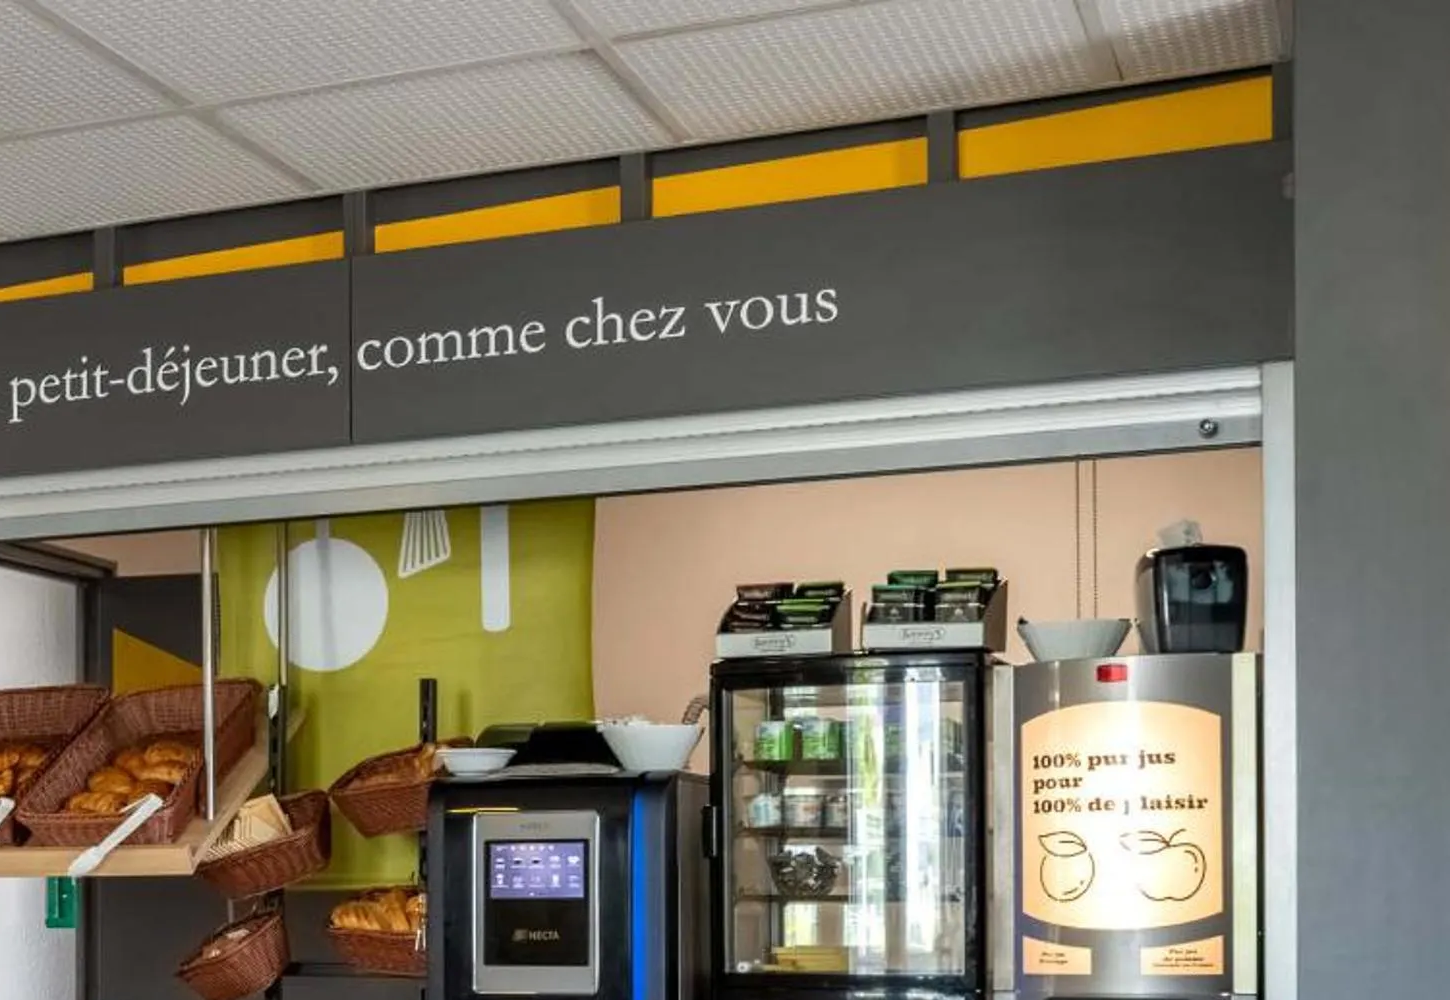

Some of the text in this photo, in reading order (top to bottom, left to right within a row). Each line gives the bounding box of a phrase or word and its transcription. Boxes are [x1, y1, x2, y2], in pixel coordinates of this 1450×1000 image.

[9, 344, 339, 424] petit-déjeuner,
[357, 321, 546, 371] comme
[565, 296, 686, 349] chez
[704, 288, 839, 334] vous
[1033, 753, 1082, 769] 100%
[1137, 750, 1176, 769] jus
[1033, 776, 1083, 794] pour
[1033, 798, 1082, 814] 100%
[1087, 797, 1115, 812] de
